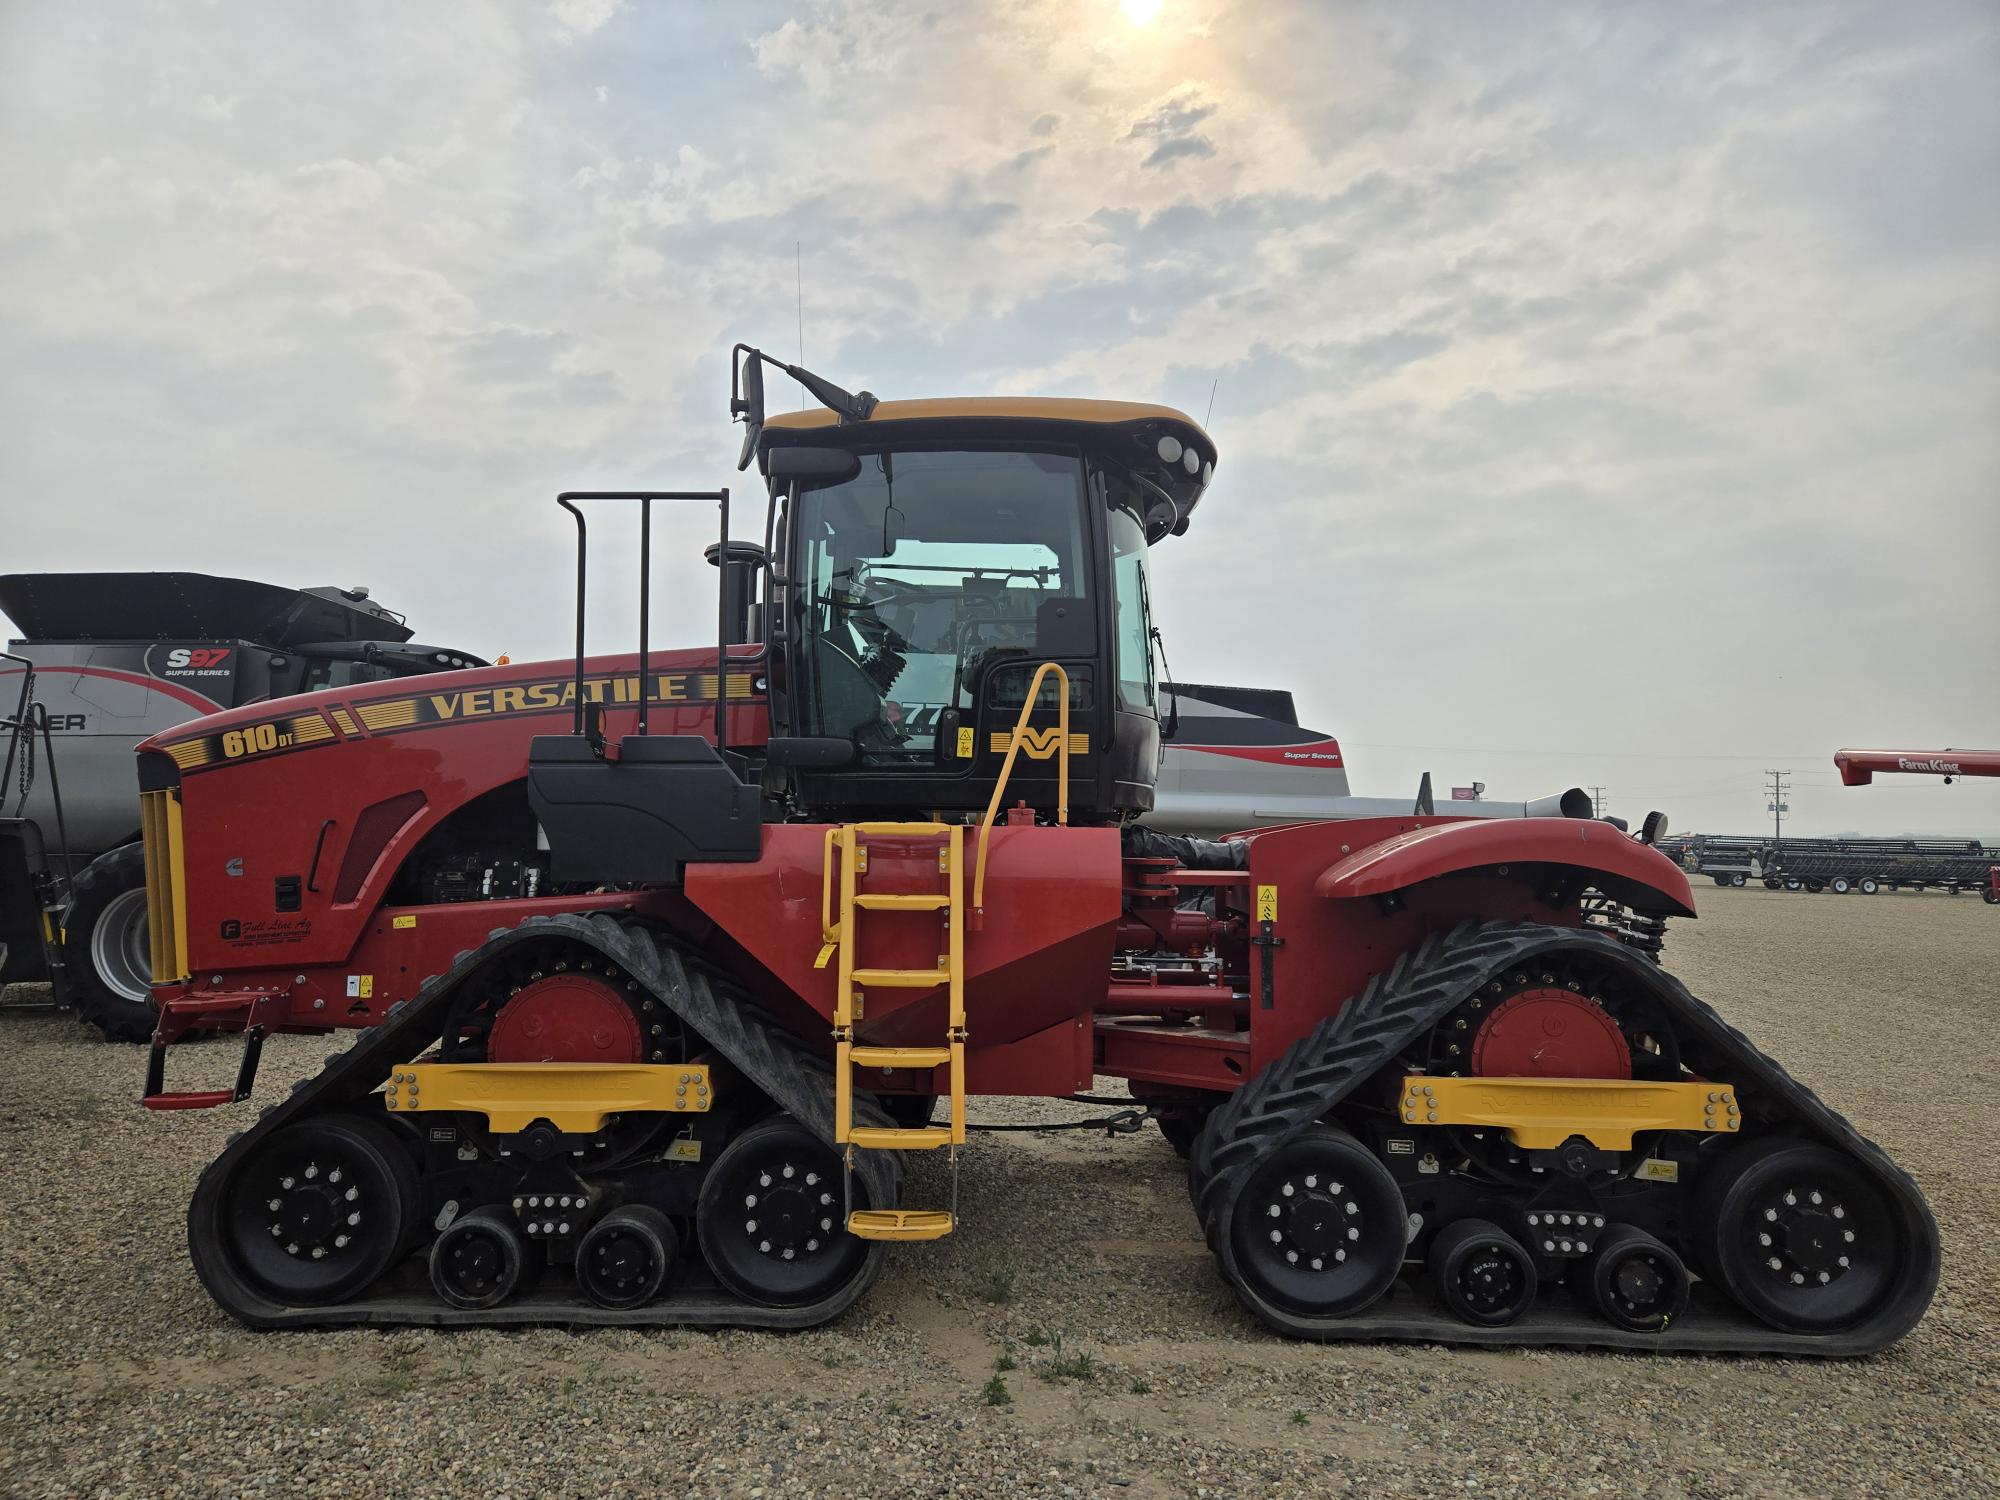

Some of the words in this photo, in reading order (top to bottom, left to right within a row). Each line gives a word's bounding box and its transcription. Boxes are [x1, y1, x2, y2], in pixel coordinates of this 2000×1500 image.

[166, 648, 232, 668] S97
[430, 675, 687, 720] VERSATILE
[1283, 751, 1310, 760] Super
[1311, 752, 1338, 760] Seven
